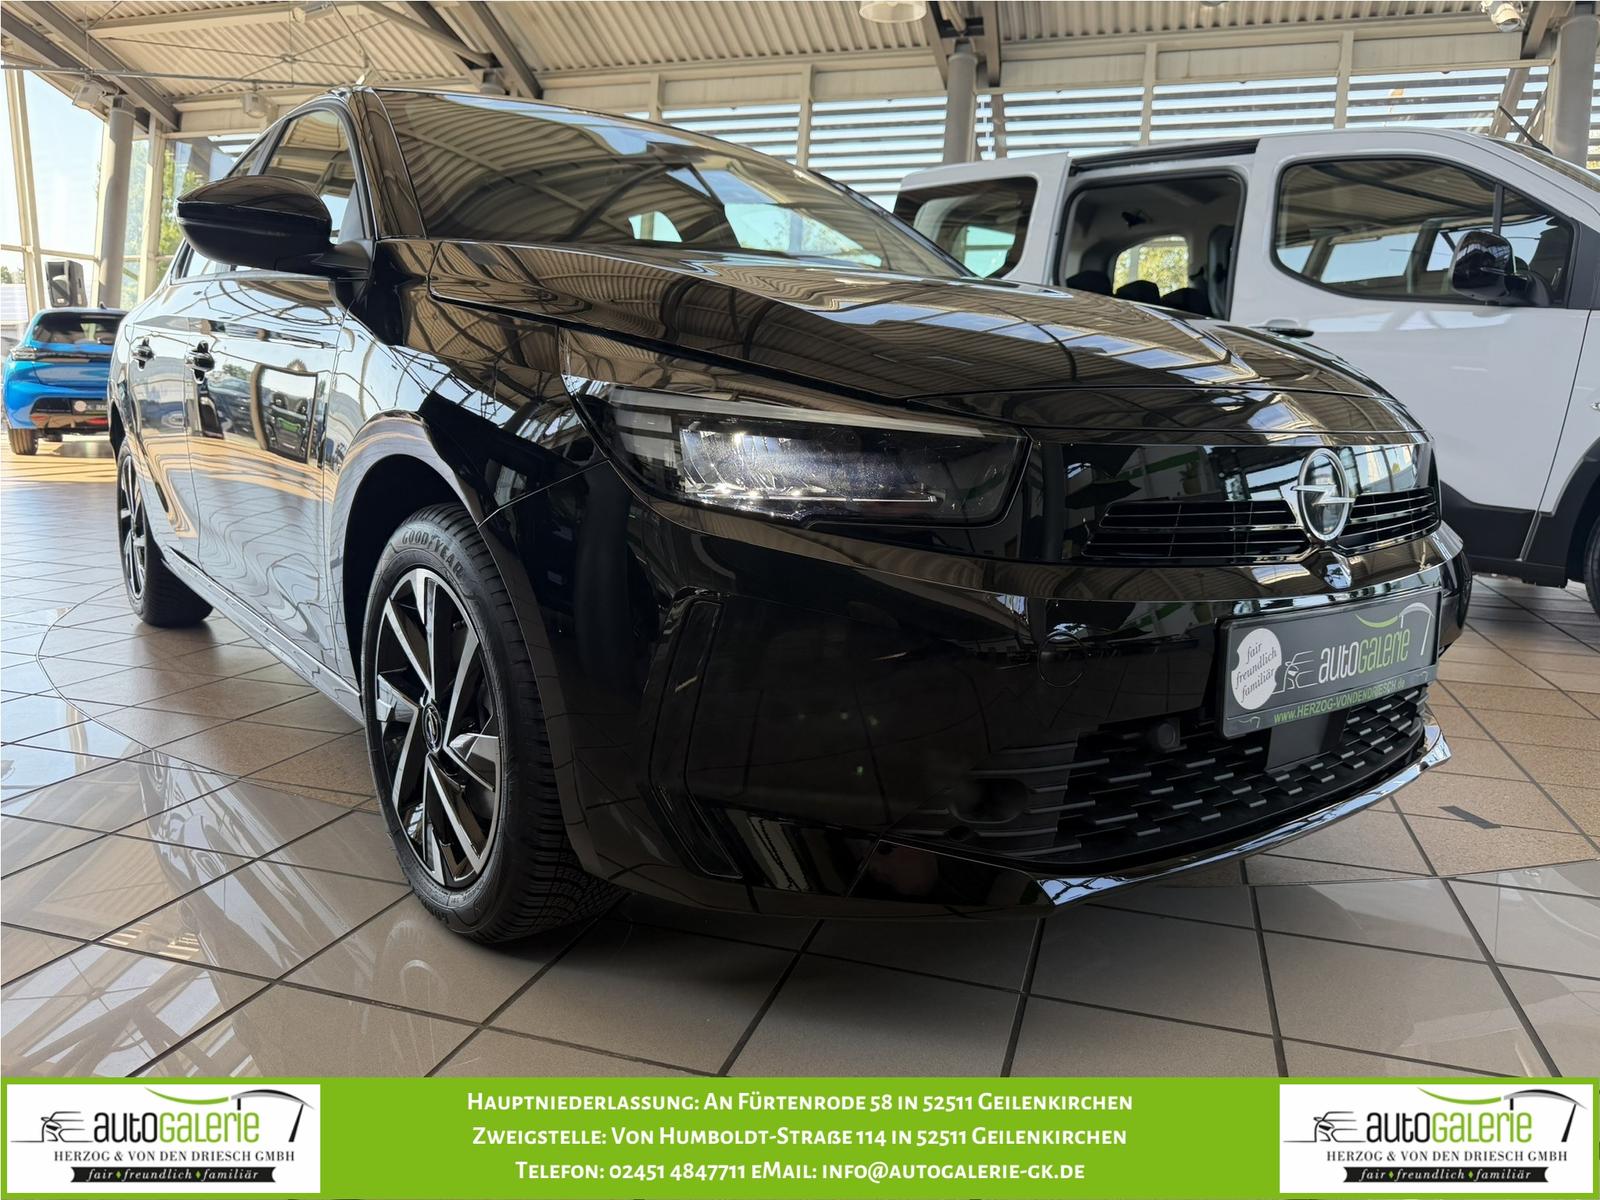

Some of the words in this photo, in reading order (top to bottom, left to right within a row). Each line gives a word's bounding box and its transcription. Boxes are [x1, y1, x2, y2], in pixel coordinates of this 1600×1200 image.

[402, 530, 466, 580] GOODYEAR
[1235, 646, 1277, 690] freundlich
[1246, 642, 1263, 665] fair
[1241, 668, 1275, 703] familiär
